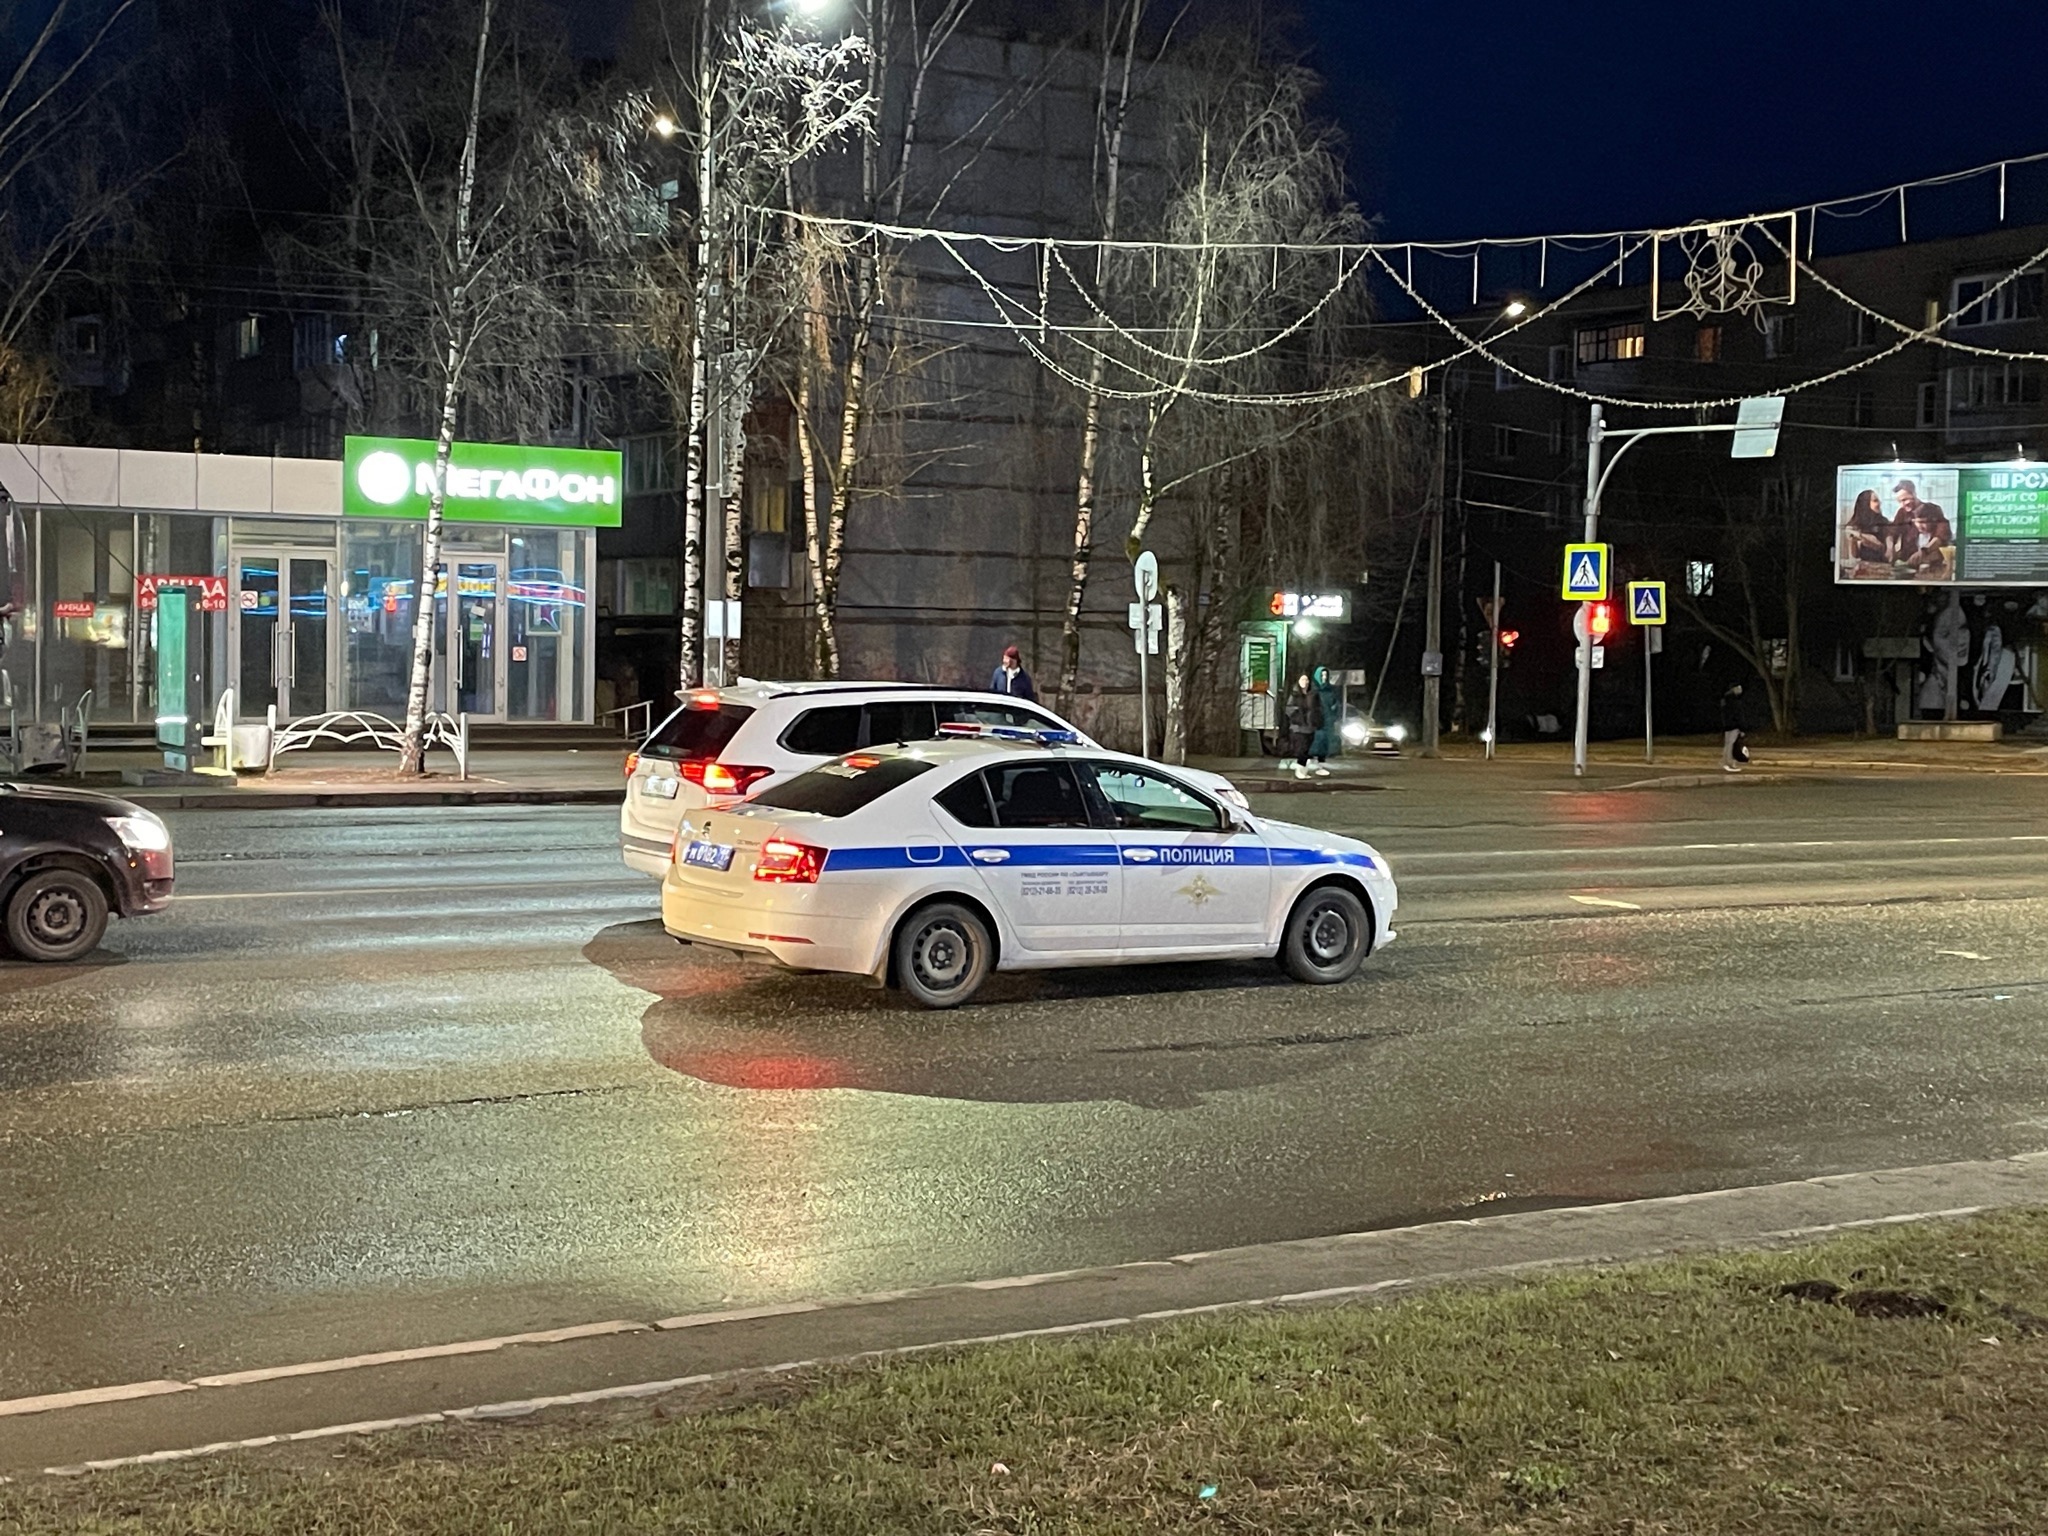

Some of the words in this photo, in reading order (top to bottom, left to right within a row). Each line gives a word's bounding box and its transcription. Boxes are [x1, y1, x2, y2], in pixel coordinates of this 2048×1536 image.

[414, 461, 615, 505] МЕГАФОН
[56, 603, 91, 612] АРЕНДА
[1160, 848, 1235, 865] ПОЛИЦИЯ
